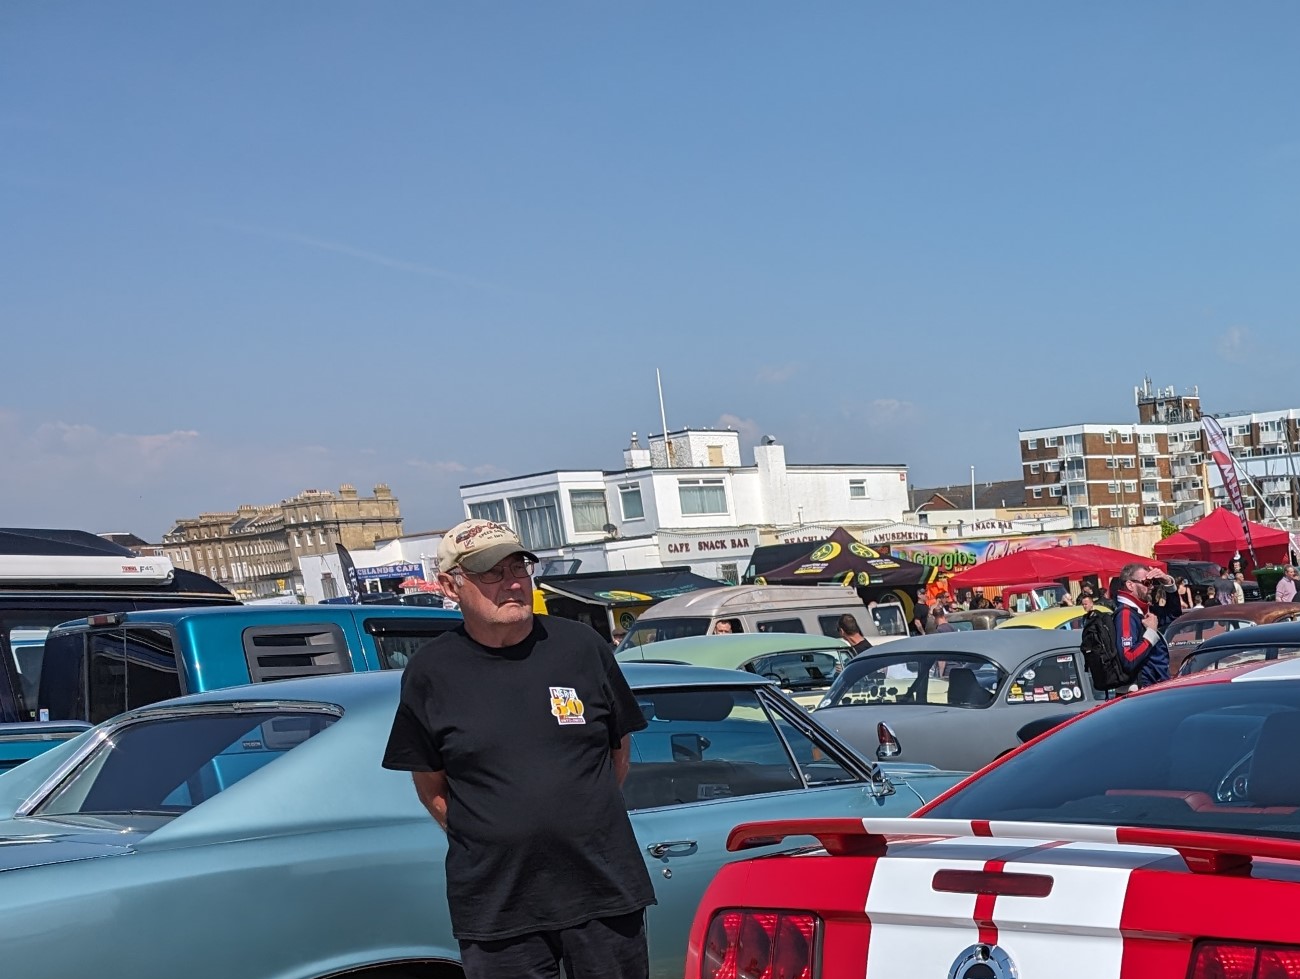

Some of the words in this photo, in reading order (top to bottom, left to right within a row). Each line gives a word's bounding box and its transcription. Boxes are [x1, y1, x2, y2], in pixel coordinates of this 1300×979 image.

[971, 521, 996, 531] NACK
[873, 531, 929, 542] AMUSEMENTS
[668, 543, 690, 553] CAFE
[698, 540, 727, 551] SNACK
[731, 538, 750, 548] BAR
[912, 548, 977, 570] Giorgios
[357, 566, 394, 576] CHLANDS
[395, 564, 420, 573] CAFE
